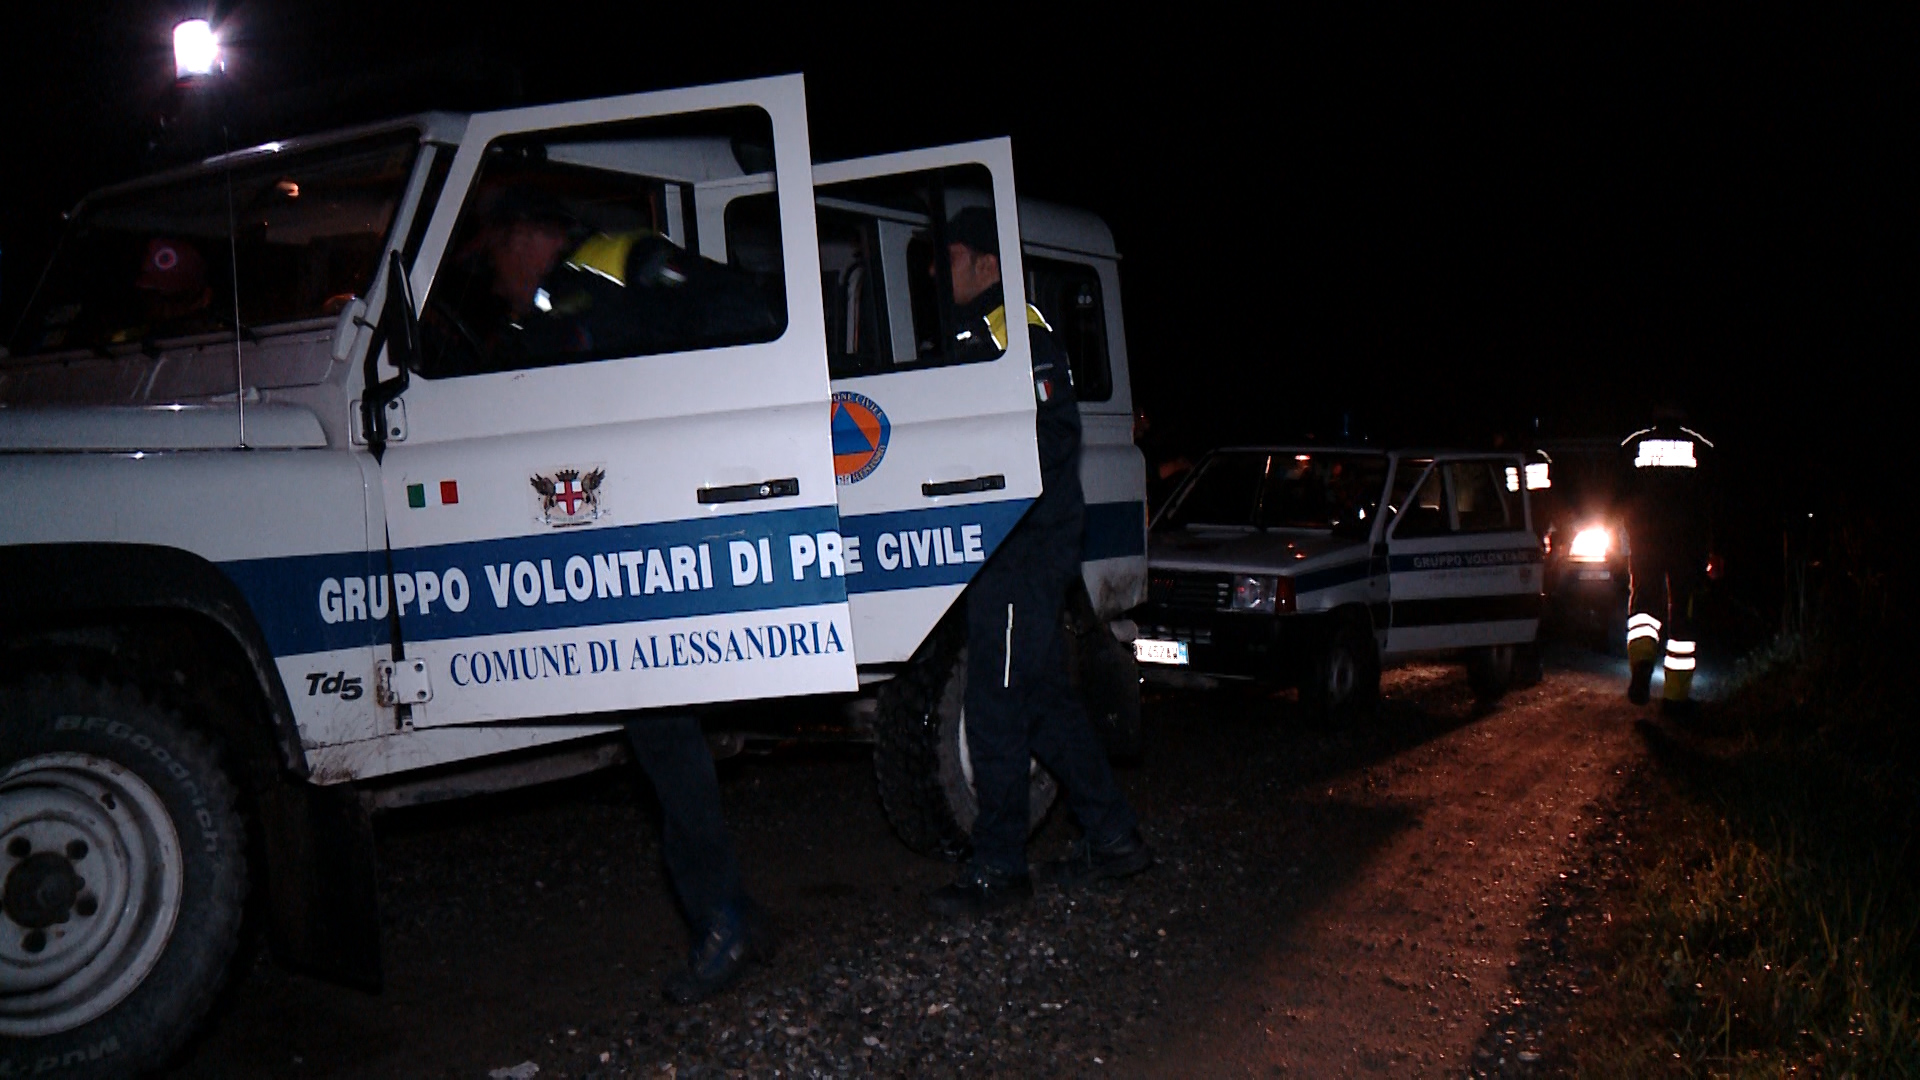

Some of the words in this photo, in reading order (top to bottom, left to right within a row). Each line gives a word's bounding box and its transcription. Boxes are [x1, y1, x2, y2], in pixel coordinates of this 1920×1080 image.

[319, 567, 470, 625] GRUPPO
[484, 543, 713, 608] VOLONTARI
[729, 537, 773, 587] DI
[877, 523, 985, 571] CIVILE
[1413, 555, 1462, 569] GRUPPO
[450, 641, 581, 687] COMUNE
[588, 639, 620, 674] DI
[630, 620, 845, 670] ALESSANDRIA
[306, 671, 363, 701] Td5
